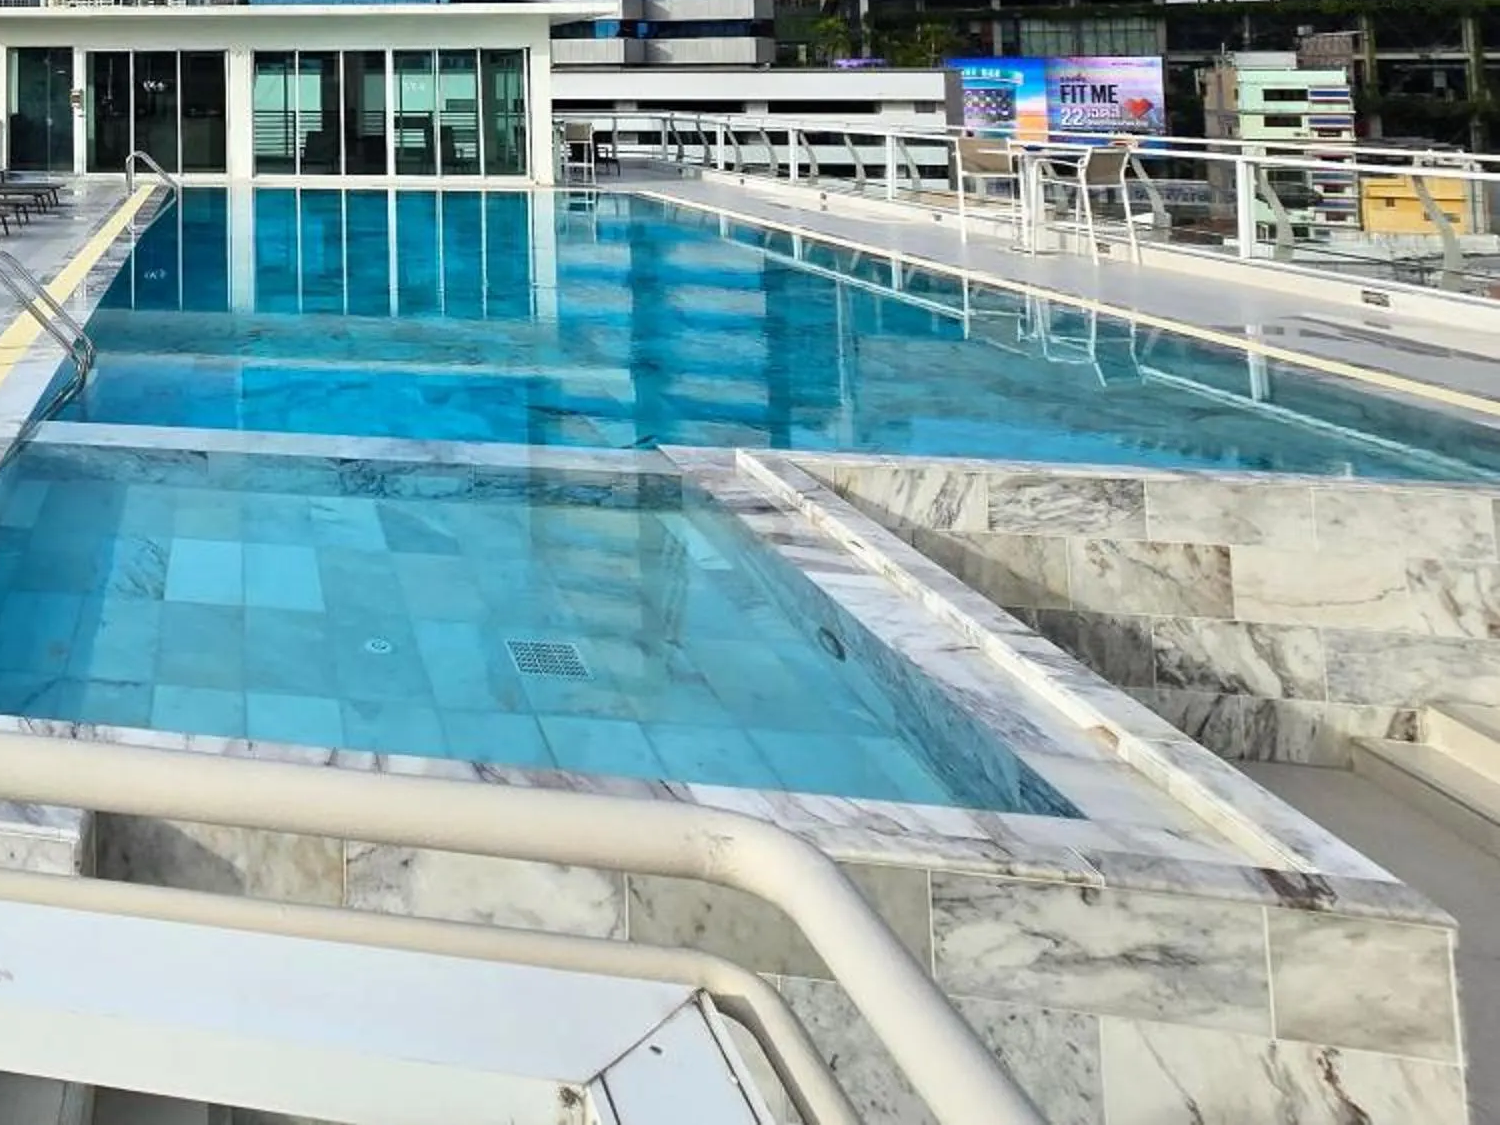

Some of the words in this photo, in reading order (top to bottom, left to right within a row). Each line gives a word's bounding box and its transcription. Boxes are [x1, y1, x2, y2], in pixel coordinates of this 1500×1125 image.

[1060, 84, 1087, 104] FIT
[1091, 84, 1119, 104] ME
[1061, 106, 1084, 126] 22
